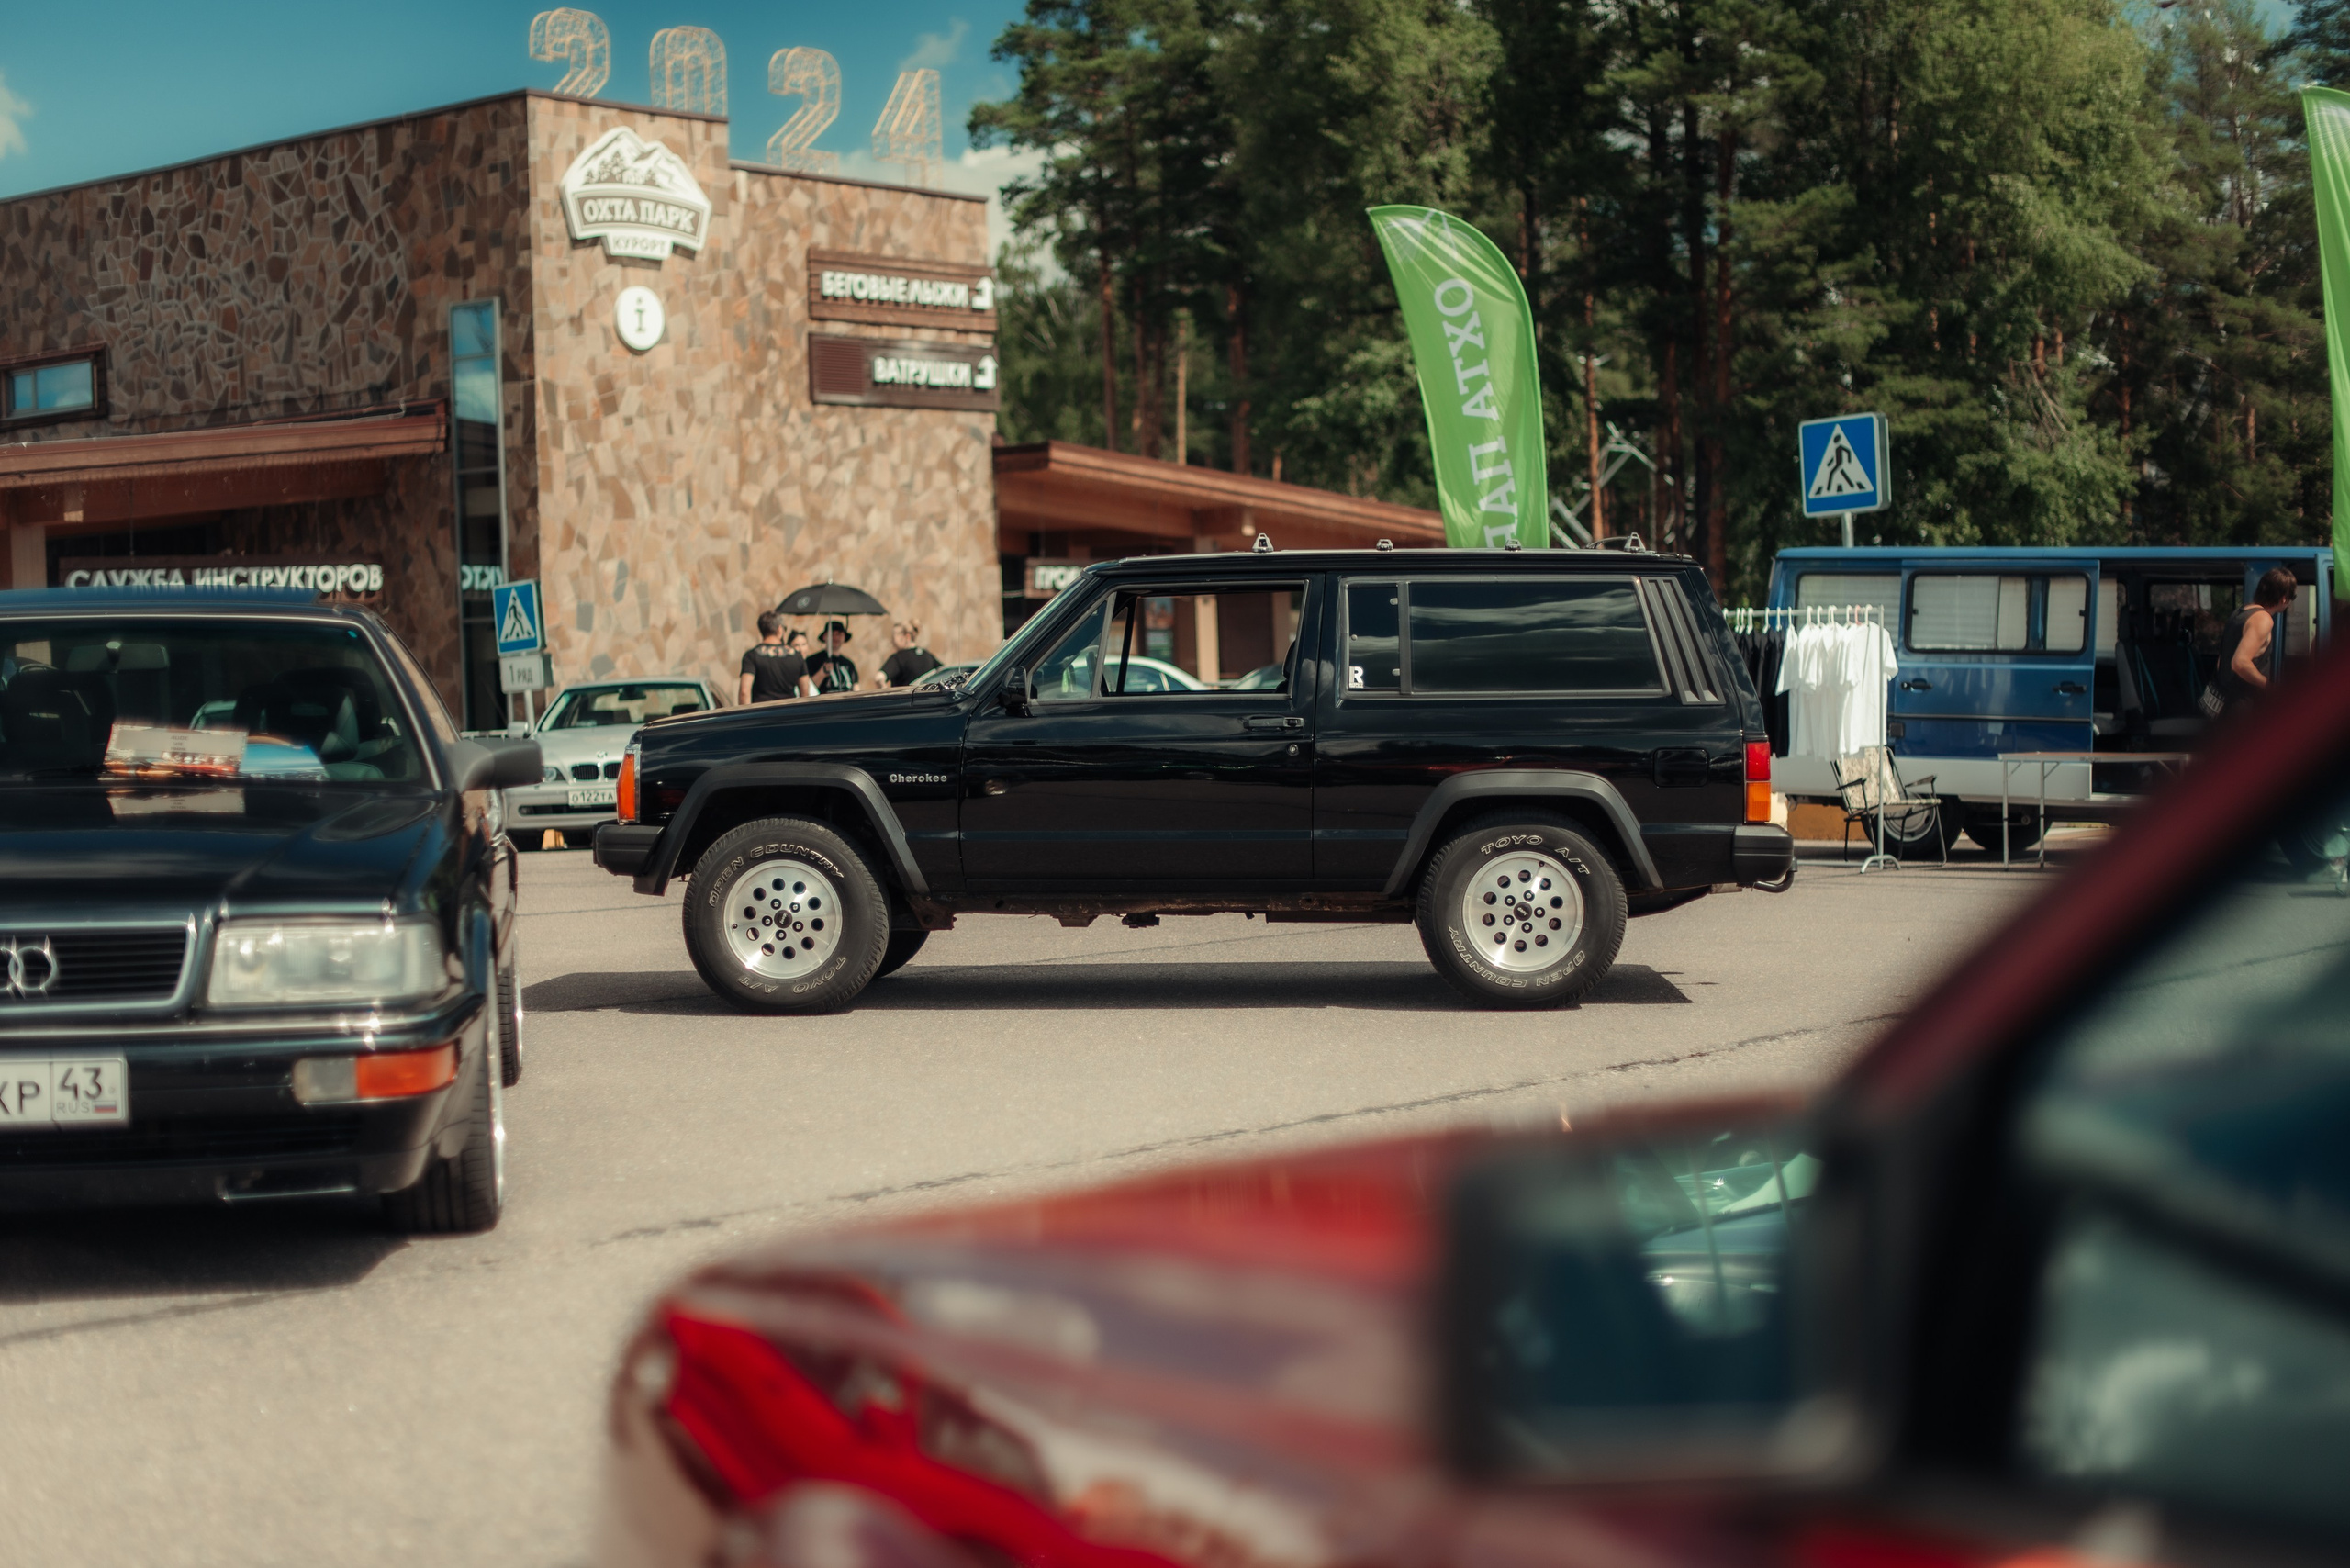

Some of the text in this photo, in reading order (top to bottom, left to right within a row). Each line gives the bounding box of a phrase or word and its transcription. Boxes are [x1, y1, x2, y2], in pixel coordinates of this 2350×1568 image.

[530, 7, 943, 189] 2024
[583, 197, 696, 233] ОХТА ПАРК
[612, 234, 666, 254] КУРОРТ
[822, 270, 969, 308] БЕГОВЫЕ ЛЫЖИ
[874, 356, 971, 387] ВАТРУШКИ
[191, 564, 384, 593] ИНСТРУКТОРОВ
[509, 664, 515, 685] 1
[889, 773, 947, 783] Cherokee
[1481, 834, 1591, 876] TOYO A/T
[709, 843, 845, 908] OPEN COUNTRY
[1448, 925, 1585, 988] OPEN COUNTRY
[738, 956, 846, 994] TOYO A/T
[59, 1067, 102, 1100] 43
[56, 1102, 90, 1114] RUS
